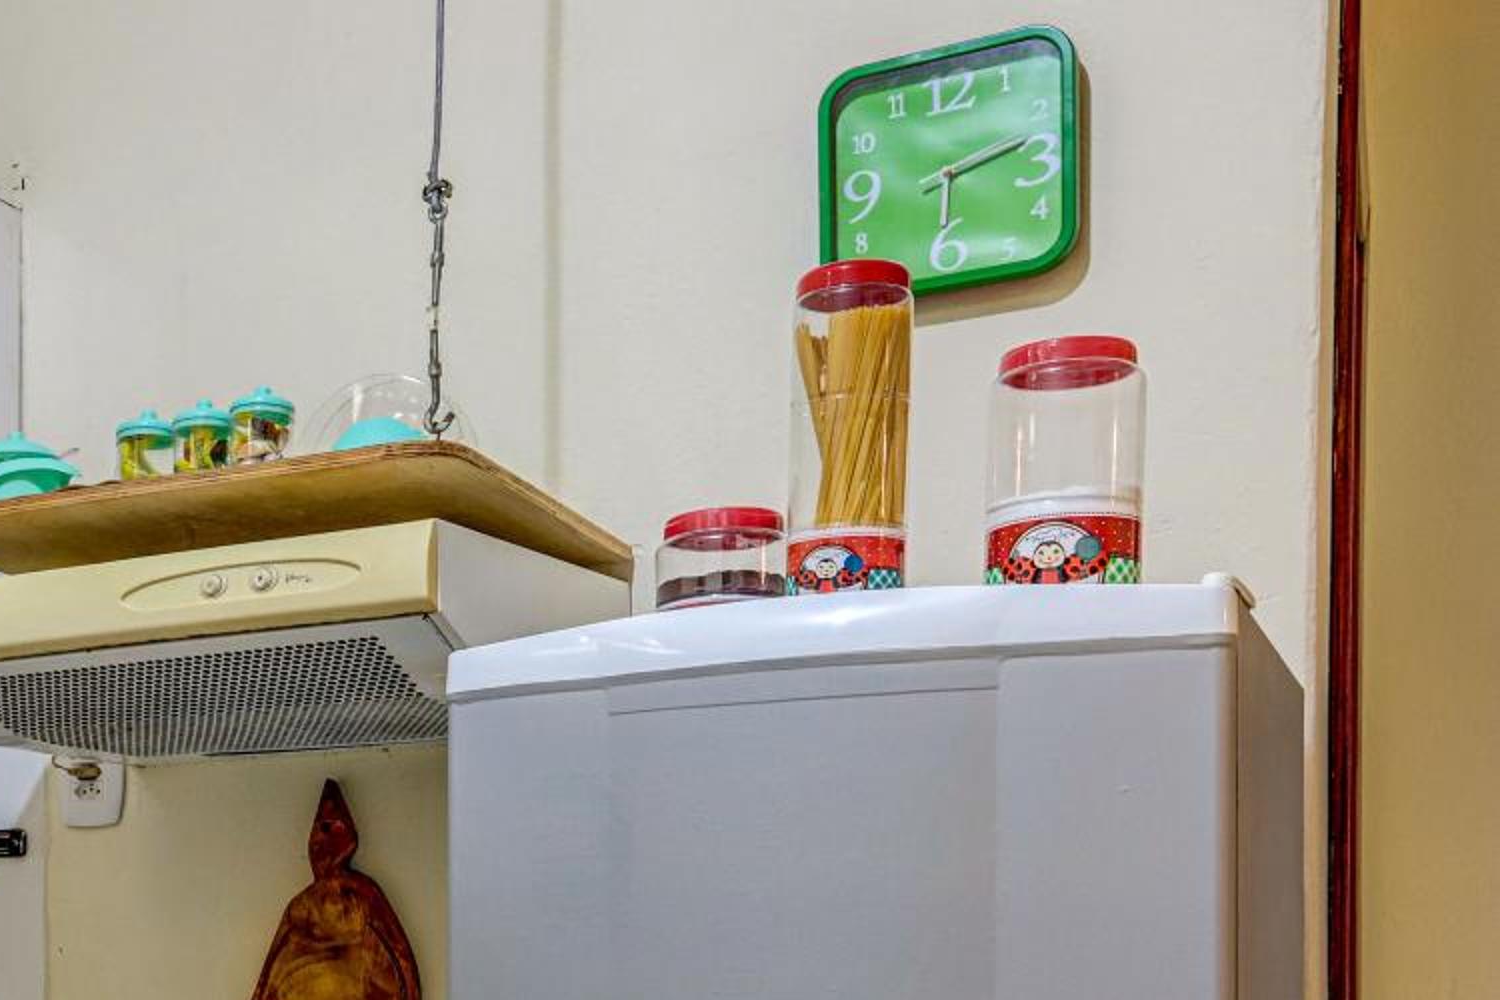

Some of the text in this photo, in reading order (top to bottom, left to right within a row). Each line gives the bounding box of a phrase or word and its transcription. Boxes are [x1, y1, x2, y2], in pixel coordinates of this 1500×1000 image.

[999, 65, 1011, 93] 1
[888, 92, 906, 119] 11
[922, 71, 976, 117] 12
[1029, 99, 1049, 121] 2
[852, 132, 876, 154] 10
[1014, 133, 1061, 187] 3
[843, 170, 882, 224] 9
[1029, 196, 1049, 221] 4
[855, 232, 869, 254] 8
[930, 217, 968, 272] 6
[1001, 236, 1018, 260] 5
